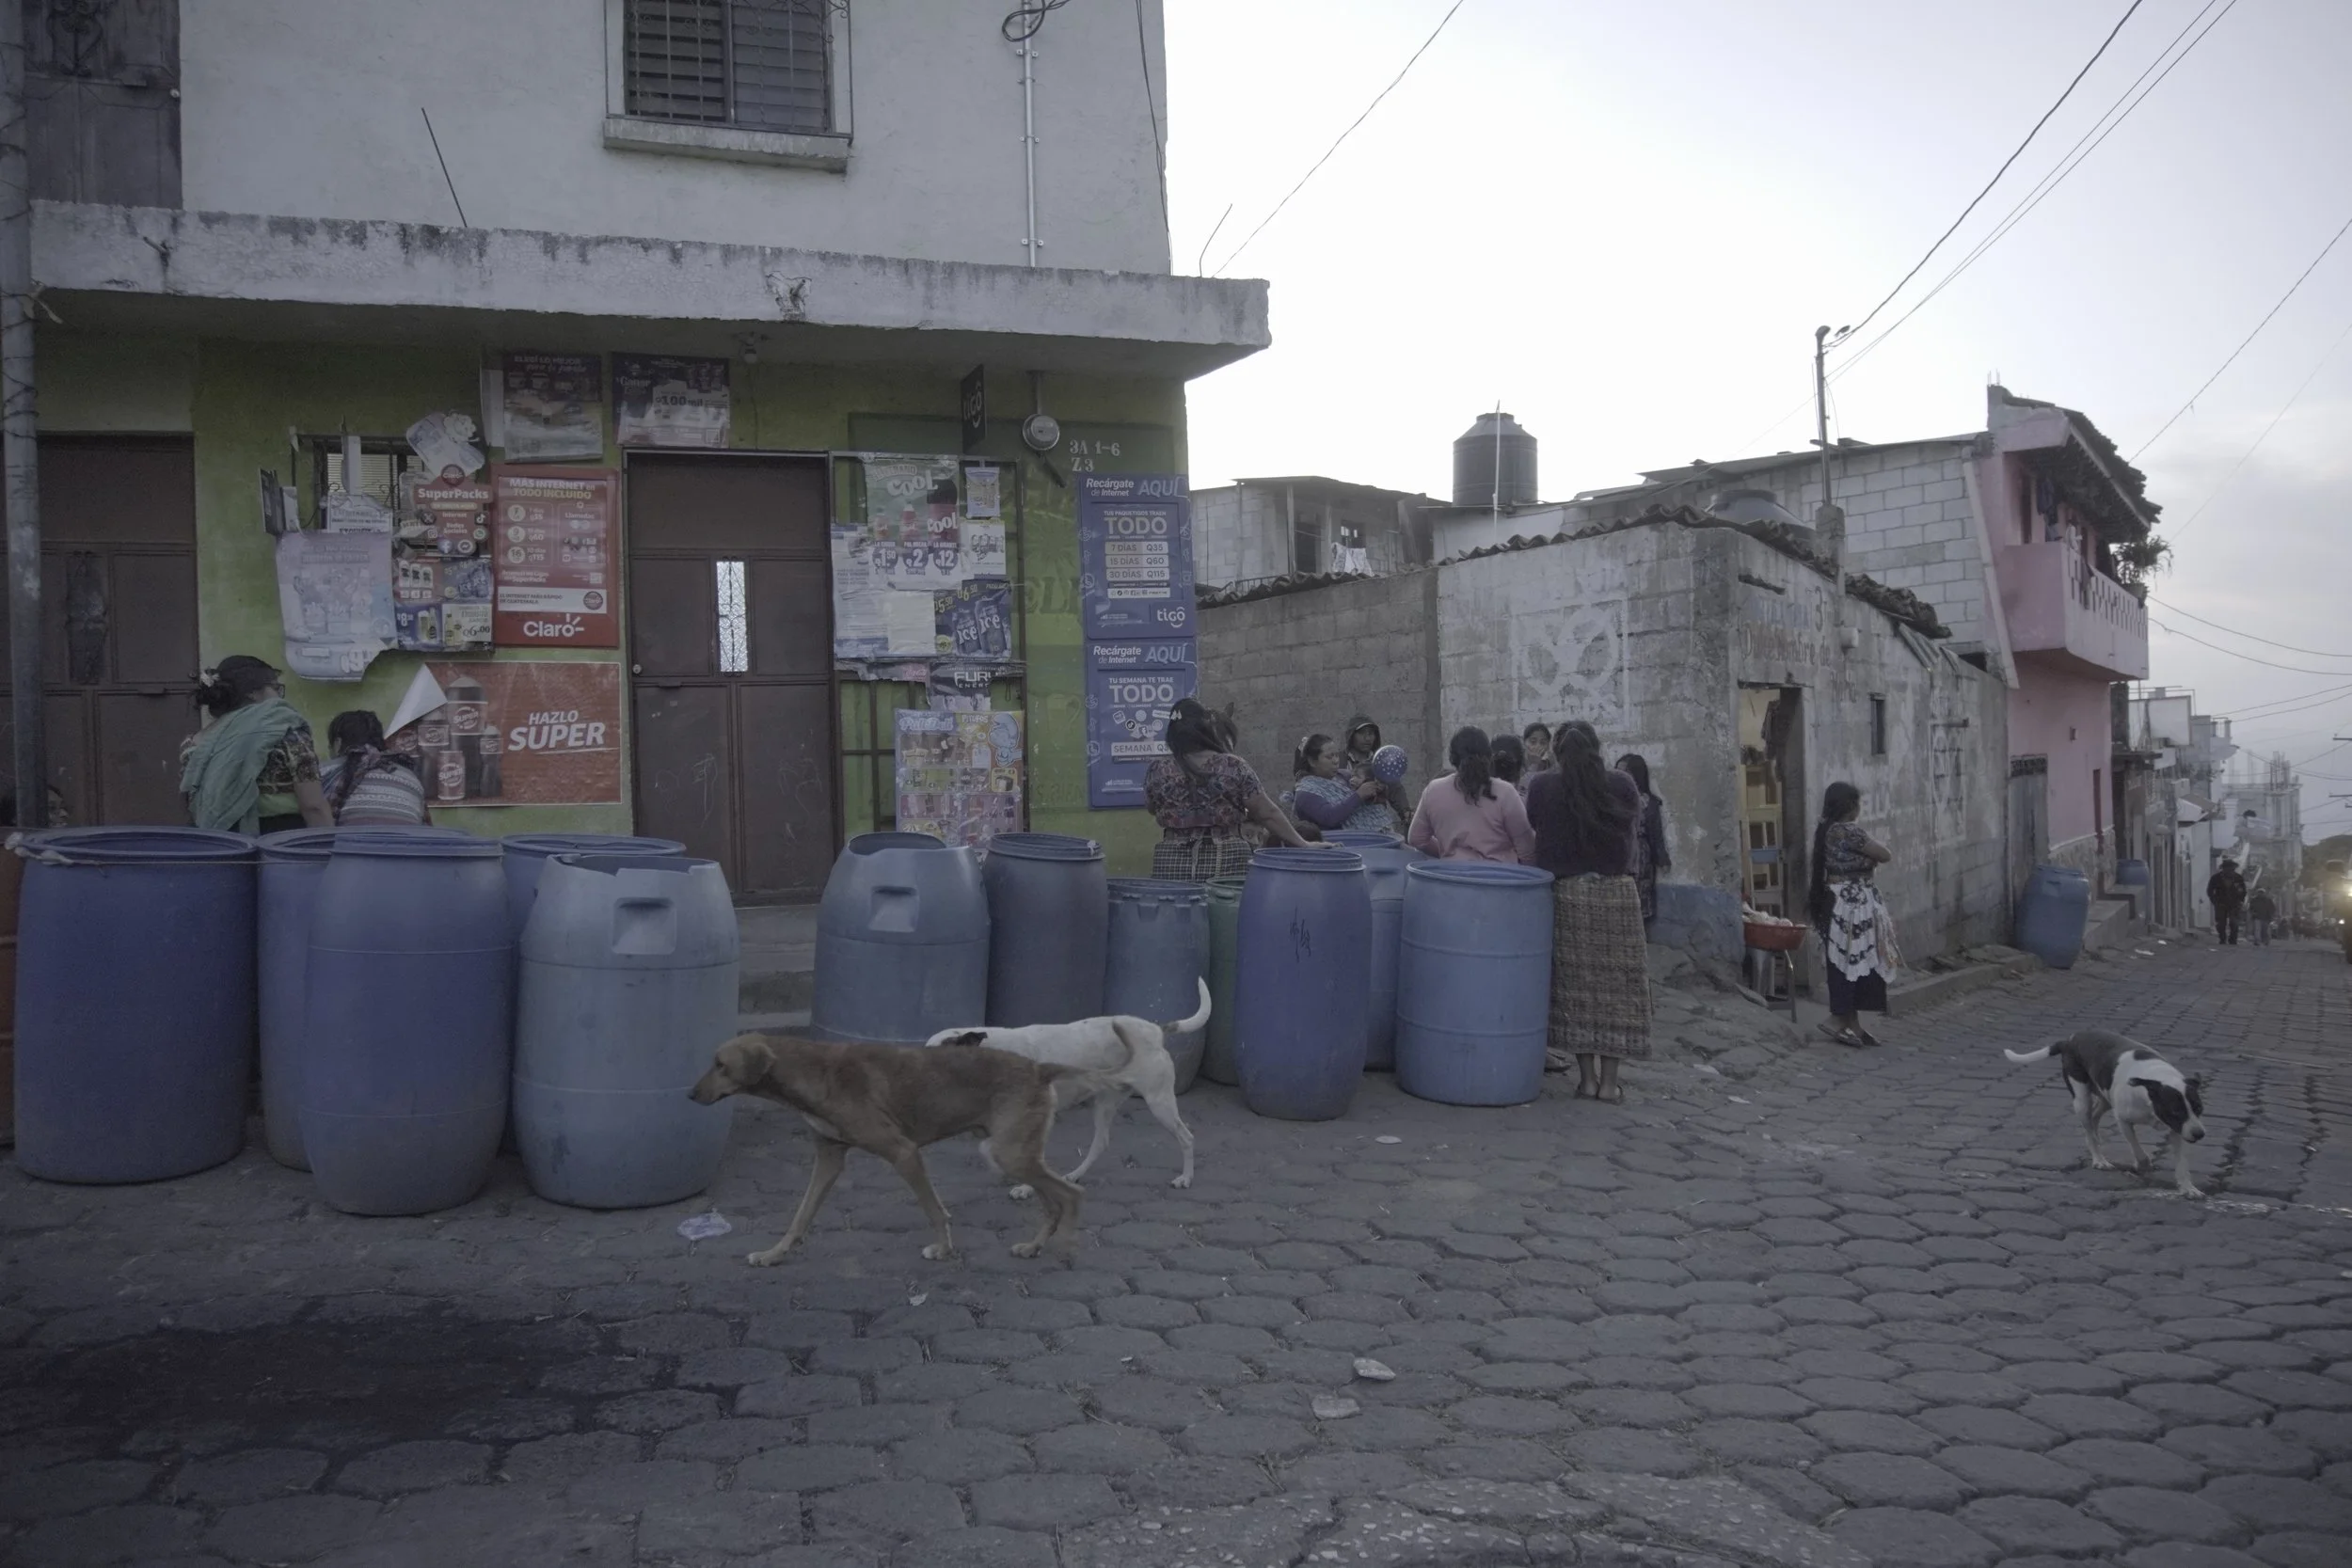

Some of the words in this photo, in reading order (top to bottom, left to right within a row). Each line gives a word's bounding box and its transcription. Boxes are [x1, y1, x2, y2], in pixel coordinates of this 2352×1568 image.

[535, 479, 585, 491] INTERNET
[1086, 477, 1135, 490] Recárgate
[418, 488, 489, 500] SuperPacks
[514, 487, 542, 497] TODO
[543, 489, 592, 499] INCLUIDO
[1104, 516, 1168, 534] TODO
[1118, 543, 1137, 551] DÍAS
[1146, 544, 1164, 552] Q35
[1120, 555, 1140, 564] DÍAS
[1122, 569, 1141, 578] DÍAS
[1147, 570, 1166, 578] Q115
[523, 615, 582, 637] Claro
[1093, 645, 1142, 657] Recárgate
[1145, 643, 1187, 664] AQUÍ
[1108, 684, 1174, 703] TODO
[528, 710, 580, 725] HAZLO
[507, 721, 607, 752] SUPER
[1113, 744, 1152, 753] SEMANA
